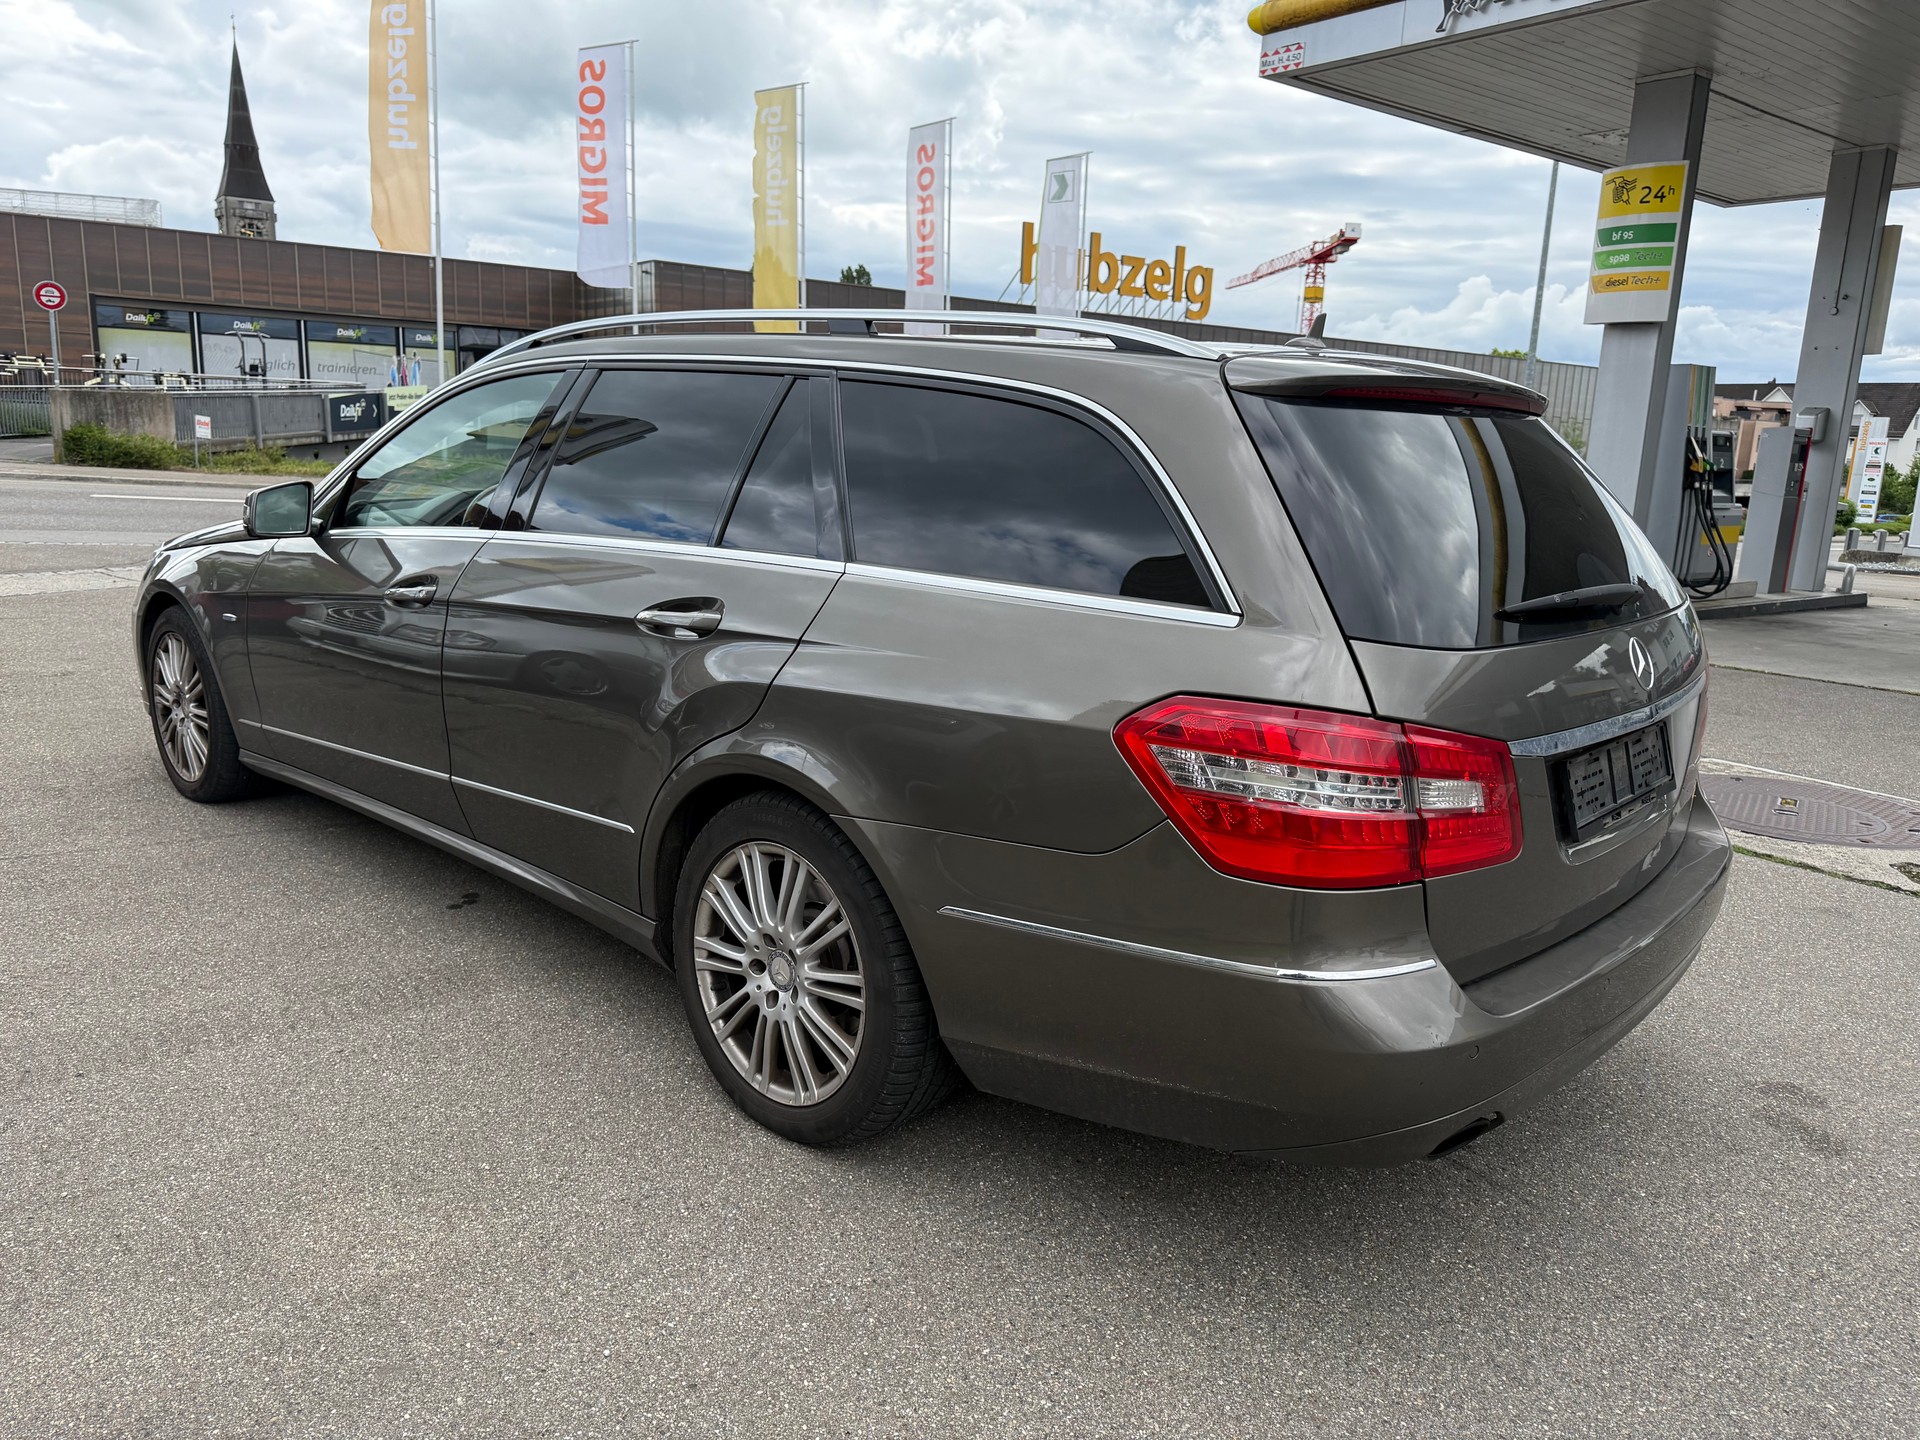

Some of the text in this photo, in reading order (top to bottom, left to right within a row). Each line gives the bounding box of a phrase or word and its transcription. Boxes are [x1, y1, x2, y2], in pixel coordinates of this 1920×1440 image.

[1612, 230, 1634, 241] bf 95
[1609, 254, 1630, 265] sp98
[1605, 276, 1629, 287] diesel
[1720, 458, 1725, 469] 2
